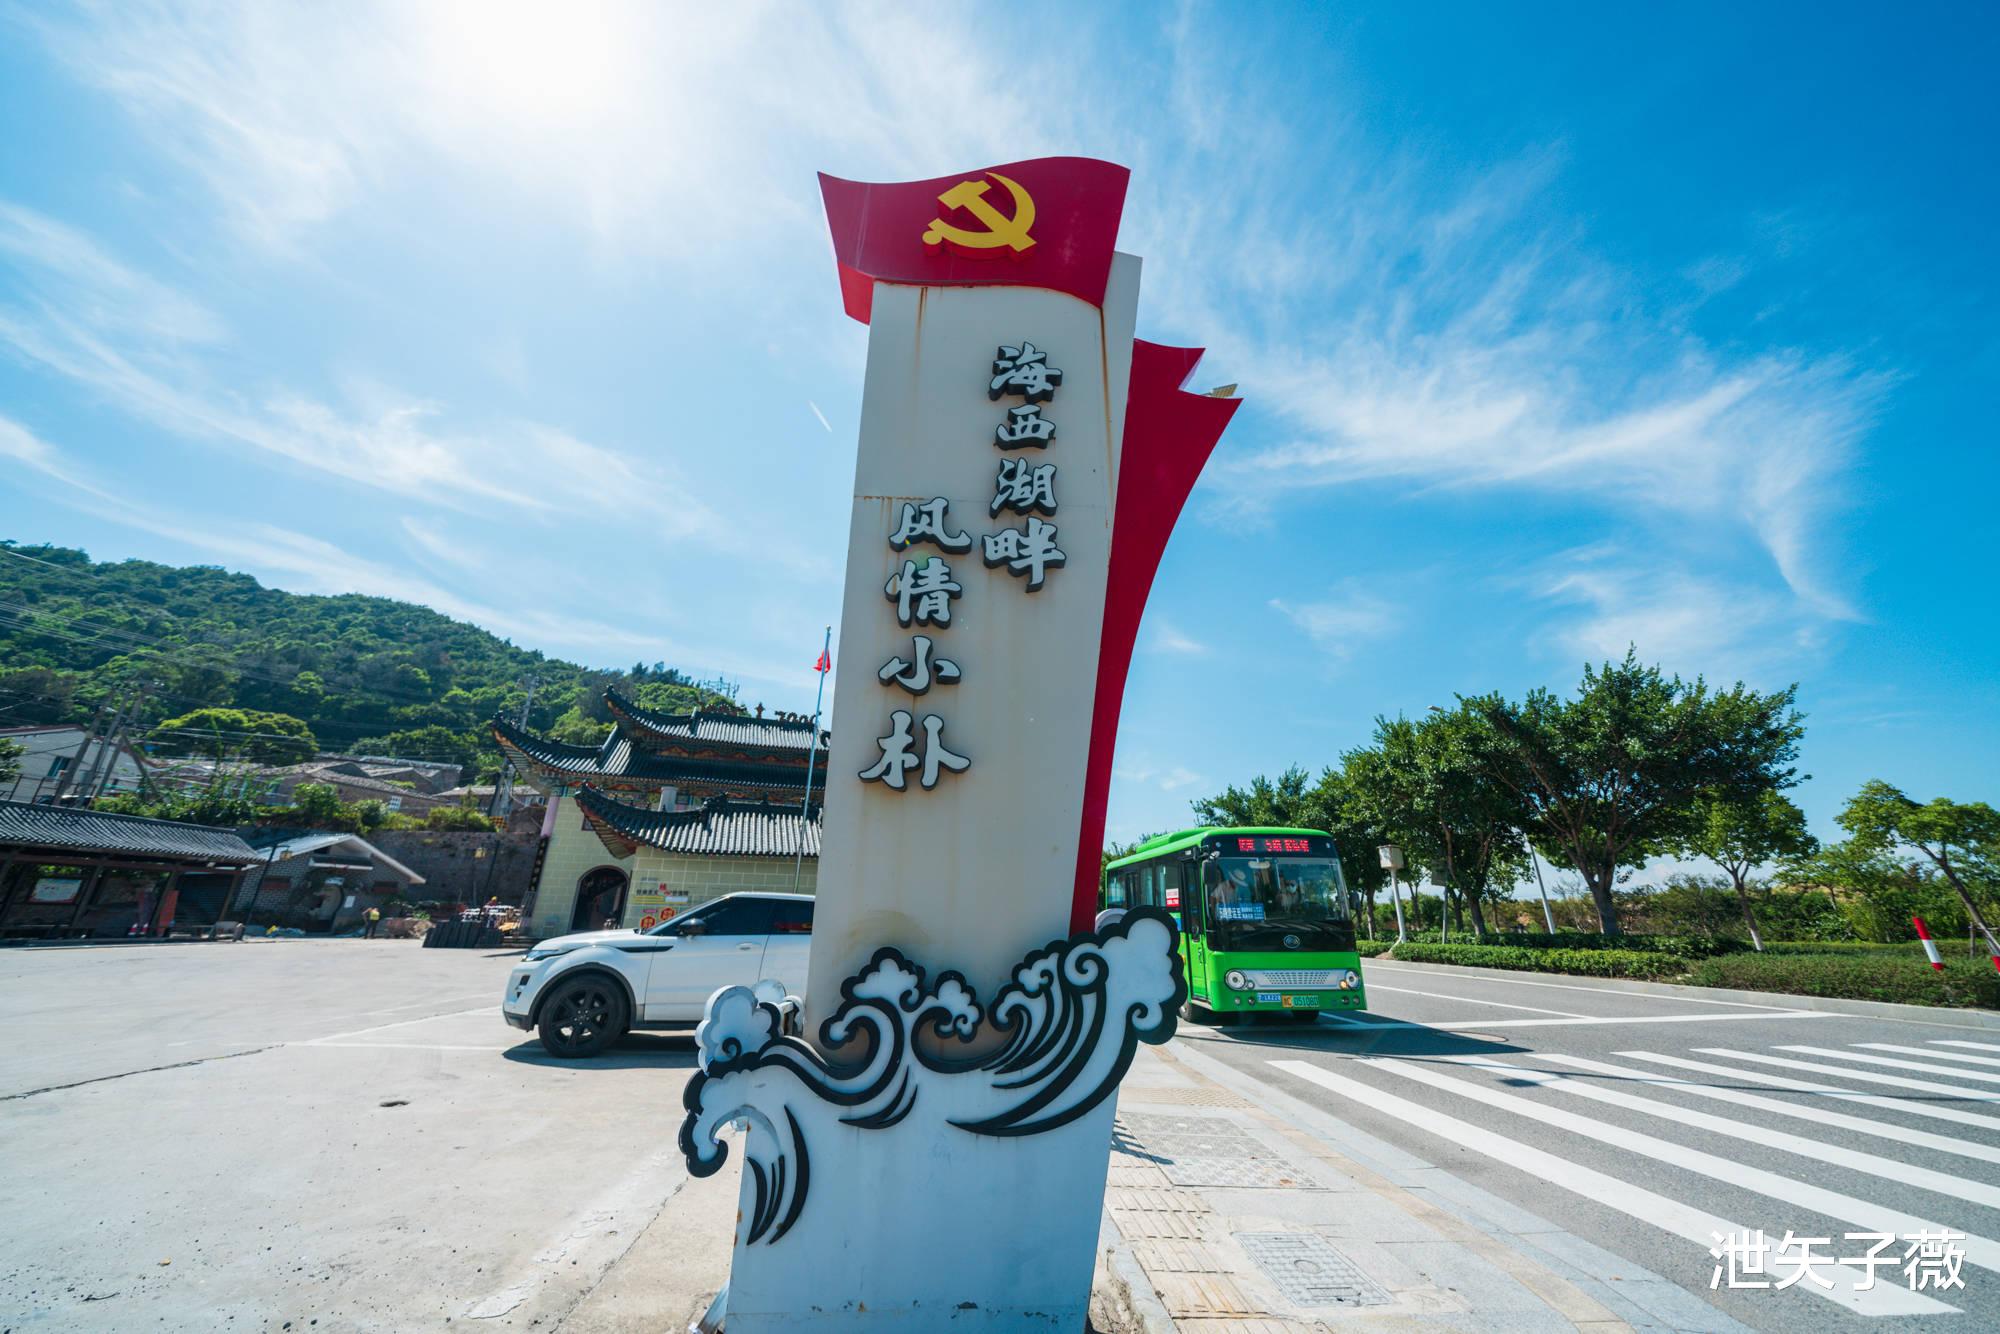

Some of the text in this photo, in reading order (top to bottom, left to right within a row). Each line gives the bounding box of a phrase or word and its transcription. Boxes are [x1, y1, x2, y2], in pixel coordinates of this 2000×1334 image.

[982, 341, 1067, 592] 海西湖畔
[858, 497, 972, 791] 风情小朴
